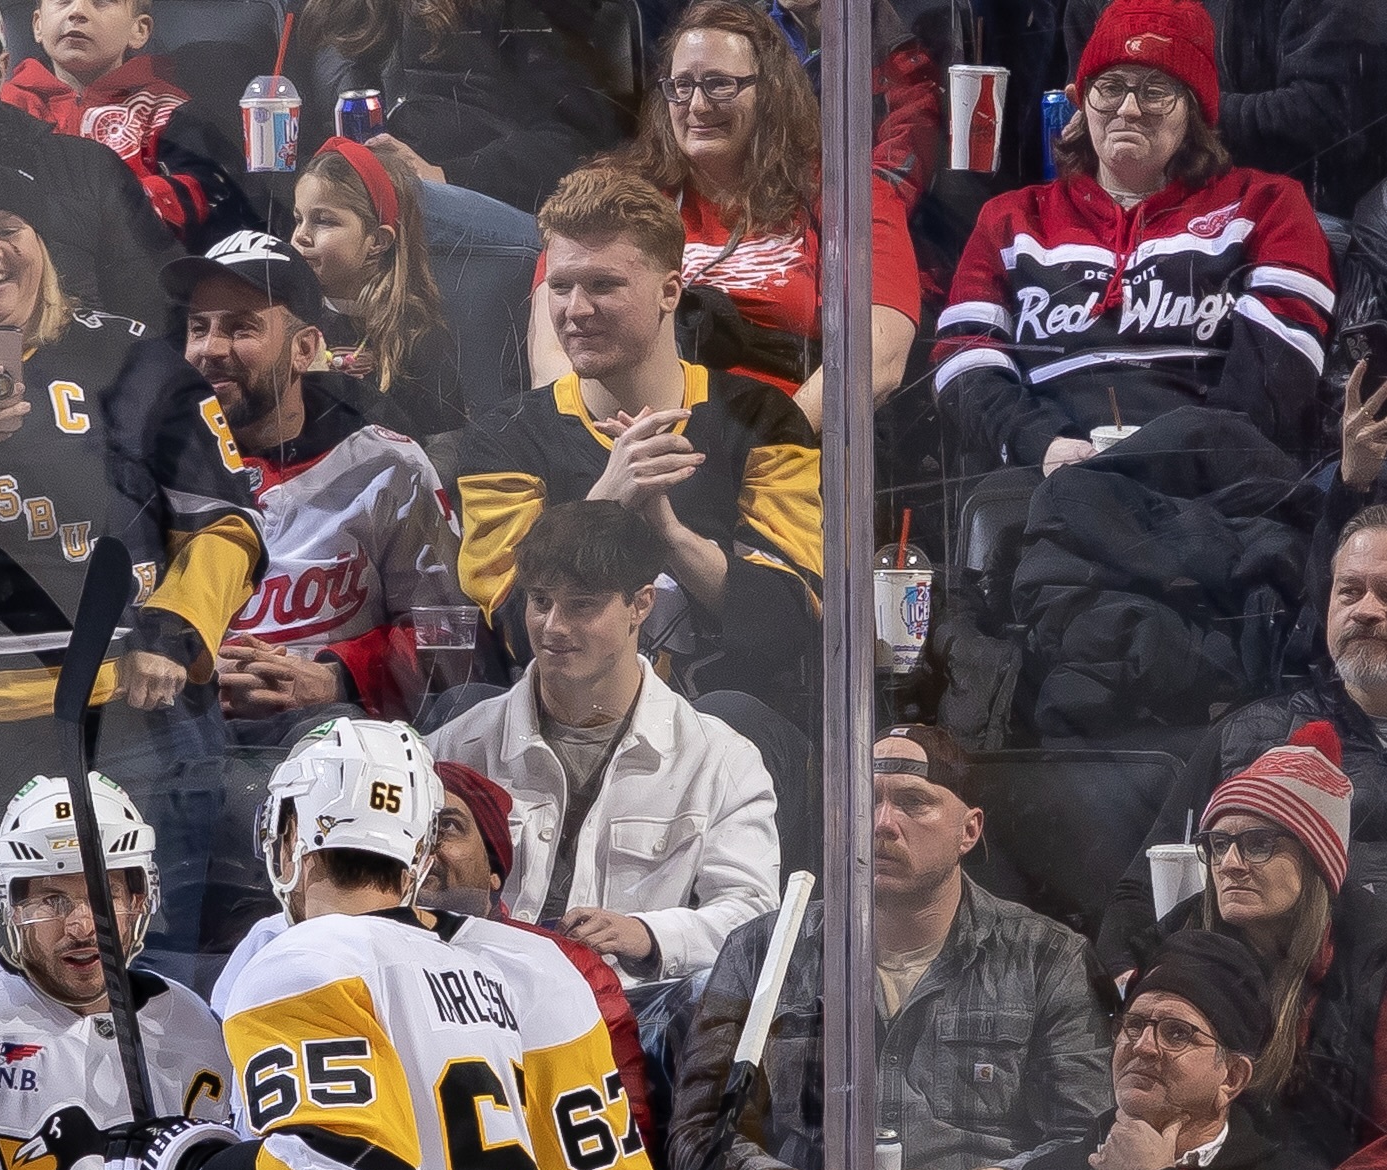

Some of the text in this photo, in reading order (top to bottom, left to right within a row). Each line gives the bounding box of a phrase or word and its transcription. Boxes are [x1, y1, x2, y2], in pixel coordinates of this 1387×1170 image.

[1016, 286, 1102, 343] Red
[47, 379, 92, 434] C
[369, 780, 404, 814] 65
[241, 1037, 376, 1136] 65
